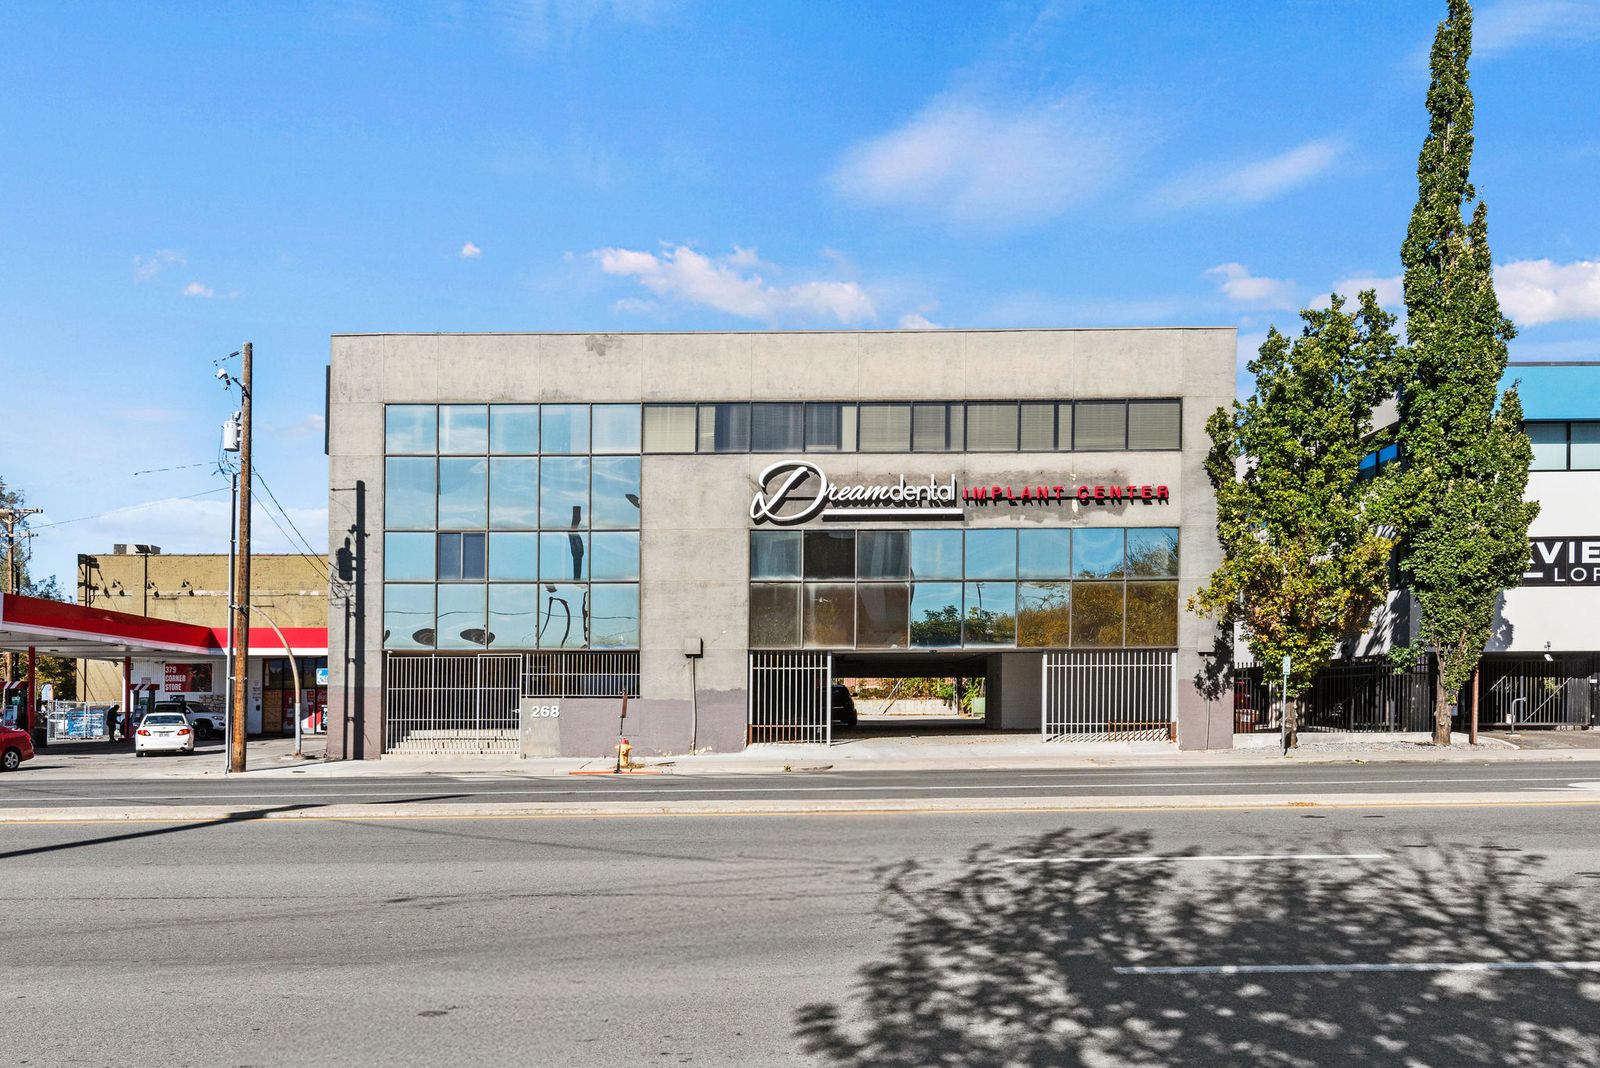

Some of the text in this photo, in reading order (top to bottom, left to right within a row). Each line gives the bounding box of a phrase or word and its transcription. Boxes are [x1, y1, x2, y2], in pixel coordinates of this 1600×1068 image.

[963, 486, 1065, 500] IMPLANT
[1077, 485, 1170, 499] CENTER
[165, 666, 177, 674] 379
[165, 674, 187, 683] CORNER
[165, 683, 182, 691] STORE
[531, 705, 560, 718] 268
